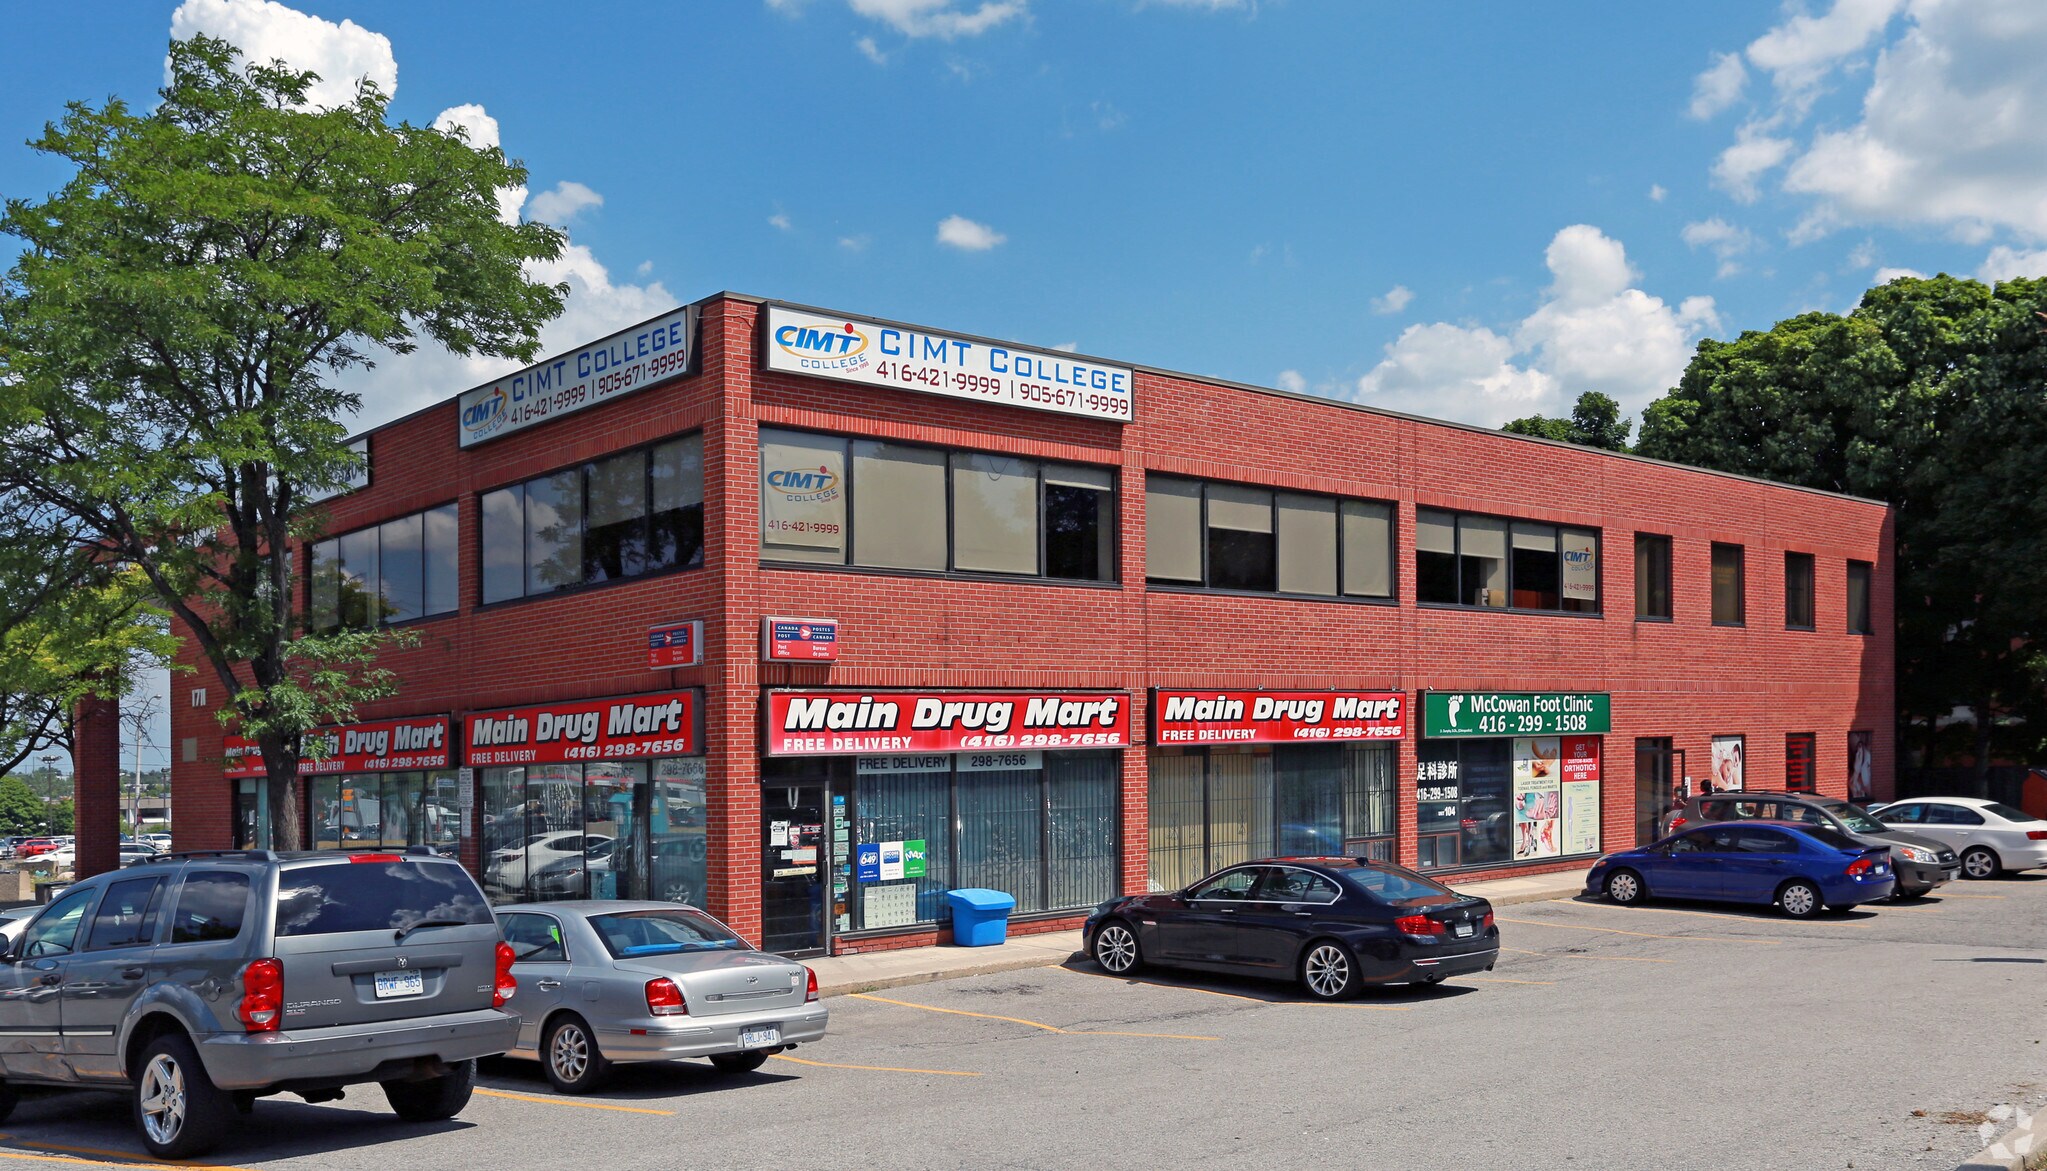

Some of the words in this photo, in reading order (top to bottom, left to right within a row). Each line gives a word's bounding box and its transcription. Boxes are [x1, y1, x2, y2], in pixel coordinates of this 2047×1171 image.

[775, 325, 861, 355] CIMT
[512, 361, 566, 402] CIMT
[578, 321, 682, 378] COLLEGE
[801, 353, 867, 369] COLLEGE
[880, 329, 971, 366] CIMT
[990, 348, 1125, 393] COLLEGE
[511, 384, 586, 424] 416-421-9999
[599, 349, 685, 396] 905-671-9999
[876, 361, 1001, 396] 416-421-9999
[1020, 383, 1129, 415] 905-671-9999
[462, 396, 503, 427] CIMT
[767, 470, 832, 490] CIMT
[786, 487, 837, 502] COLLEGE
[768, 520, 839, 534] 416-421-9999
[1564, 550, 1592, 562] CIMT
[1164, 695, 1244, 721] Main
[1252, 697, 1325, 723] Drug
[1332, 697, 1400, 720] Mart
[1470, 695, 1530, 713] McCowan
[1533, 695, 1561, 713] Foot
[1563, 694, 1594, 712] Clinic
[472, 714, 528, 747] Main
[535, 711, 600, 744] Drug
[607, 699, 683, 736] Mart
[784, 695, 899, 731] Main
[912, 697, 1013, 733] Drug
[1023, 697, 1119, 727] Mart
[1479, 715, 1506, 733] 416
[1517, 714, 1543, 732] 299
[1555, 714, 1587, 731] 1508
[345, 730, 389, 757] Drug
[394, 722, 444, 750] Mart
[783, 738, 826, 751] FREE
[832, 736, 912, 750] DELIVERY
[960, 735, 1016, 748] (416)
[1019, 733, 1121, 746] 298-7656
[1162, 729, 1195, 741] FREE
[1199, 728, 1257, 740] DELIVERY
[1293, 727, 1330, 738] (416)
[1333, 726, 1402, 737] 298-7656
[471, 752, 492, 764] FREE
[494, 750, 536, 763] DELIVERY
[564, 747, 601, 759] (416)
[604, 739, 684, 757] 298-7656
[1575, 743, 1585, 751] GET
[298, 762, 314, 772] FREE
[315, 760, 345, 771] DELIVERY
[364, 758, 389, 769] (416)
[391, 755, 445, 768] 298-7656
[858, 757, 888, 770] FREE
[892, 756, 947, 769] DELIVERY
[971, 755, 1027, 767] 298-7656
[1417, 761, 1458, 781] 足科診所
[1564, 763, 1597, 772] ORTHOTICS
[1573, 772, 1588, 780] HERE
[1444, 806, 1456, 817] 104
[905, 850, 924, 862] MAX
